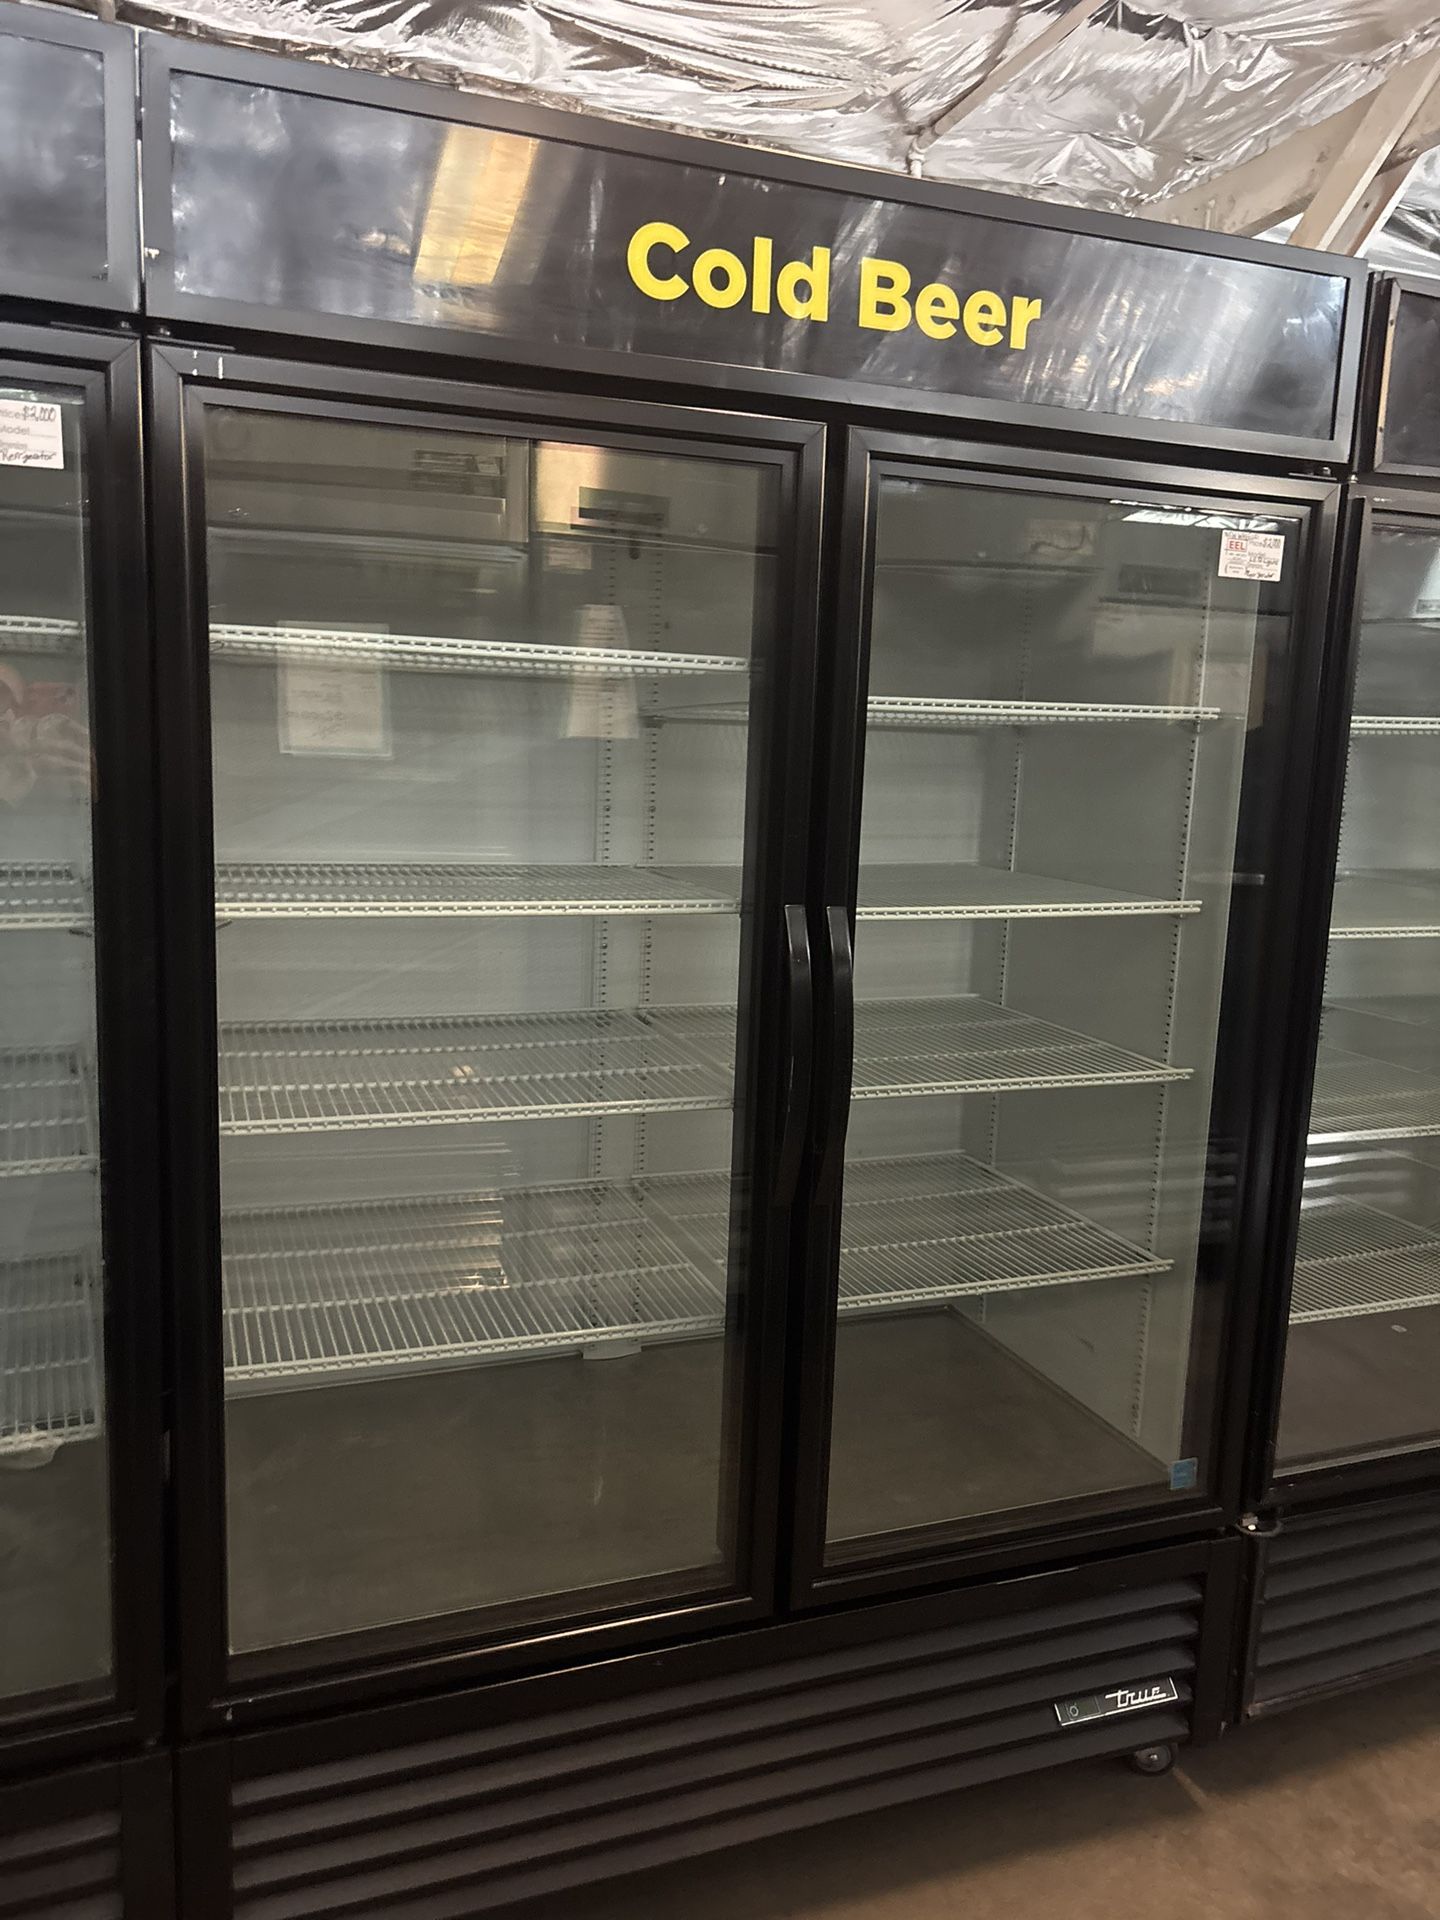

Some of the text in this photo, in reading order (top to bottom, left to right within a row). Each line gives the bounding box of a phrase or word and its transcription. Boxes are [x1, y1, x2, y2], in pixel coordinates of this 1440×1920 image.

[627, 221, 1042, 350] Cold Beer
[1229, 540, 1246, 551] EEL
